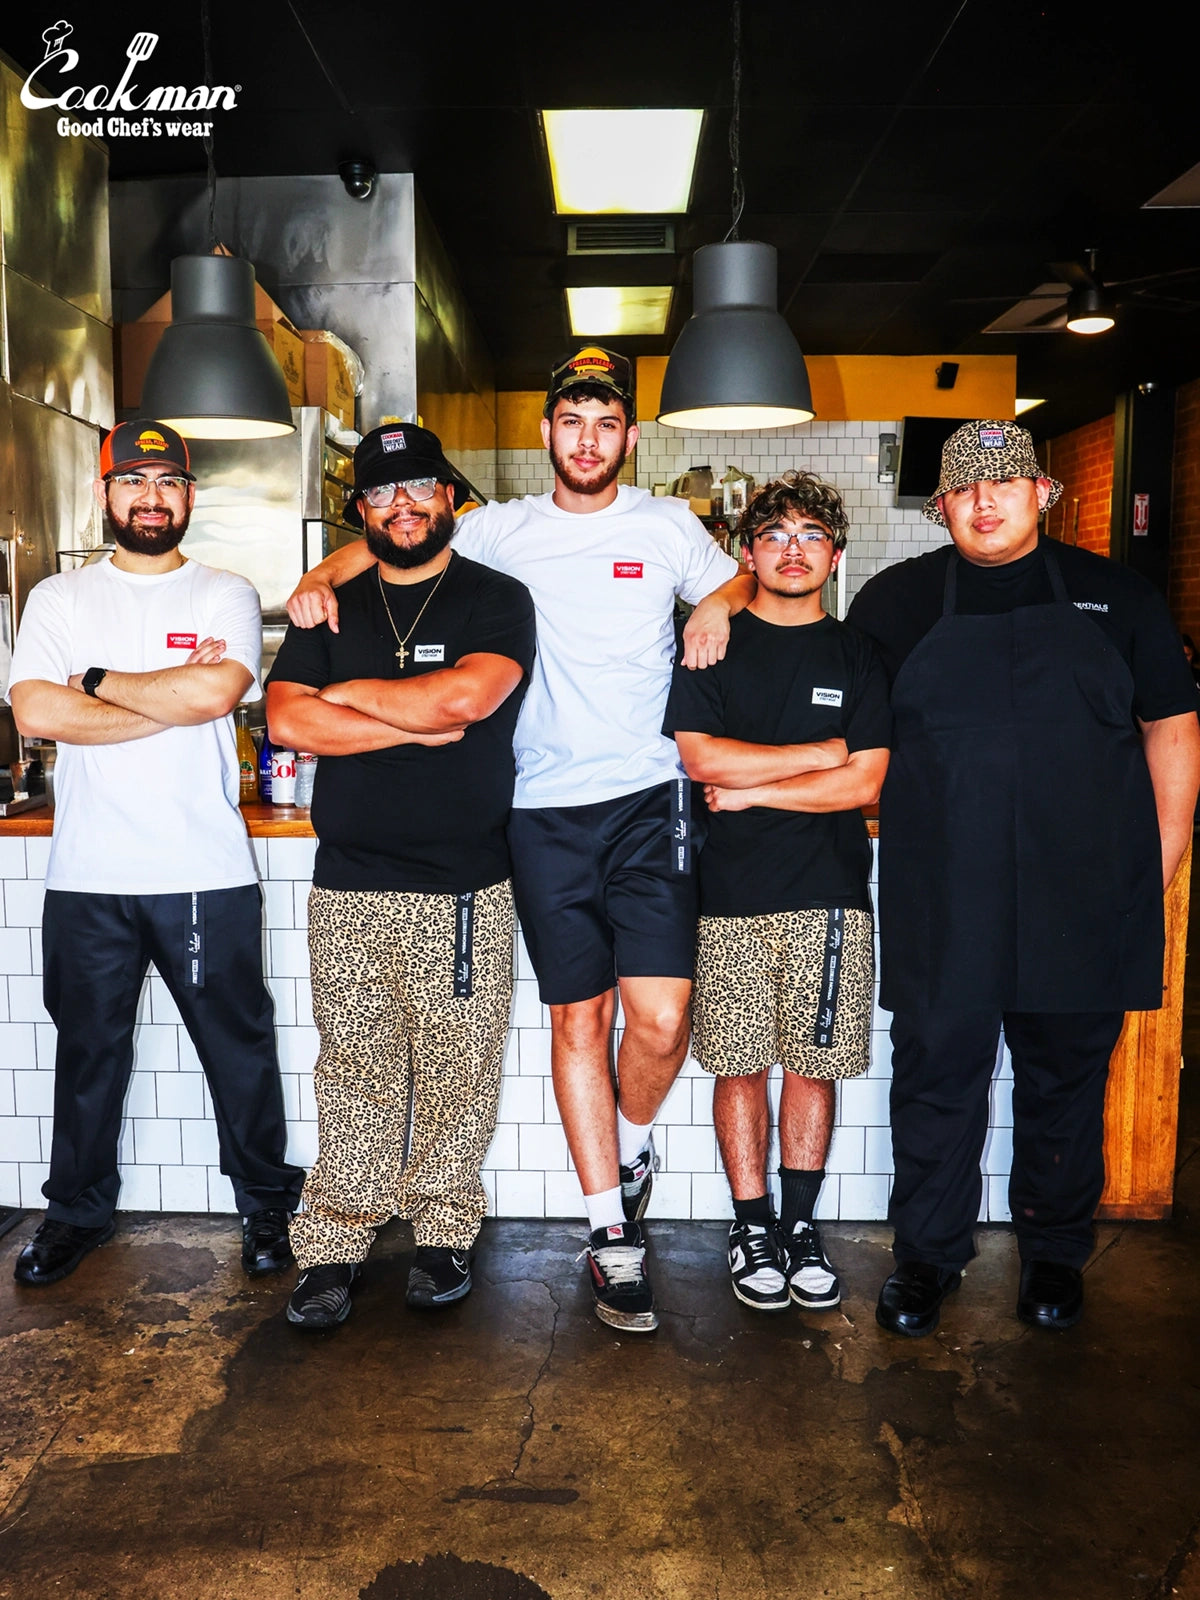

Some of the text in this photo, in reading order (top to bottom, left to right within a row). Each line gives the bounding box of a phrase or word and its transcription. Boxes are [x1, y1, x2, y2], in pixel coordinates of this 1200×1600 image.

[382, 432, 403, 440] COOKMAN
[384, 443, 405, 452] WEAR
[982, 440, 1004, 448] WEAR
[816, 691, 840, 699] VISION
[826, 981, 834, 1001] VISION
